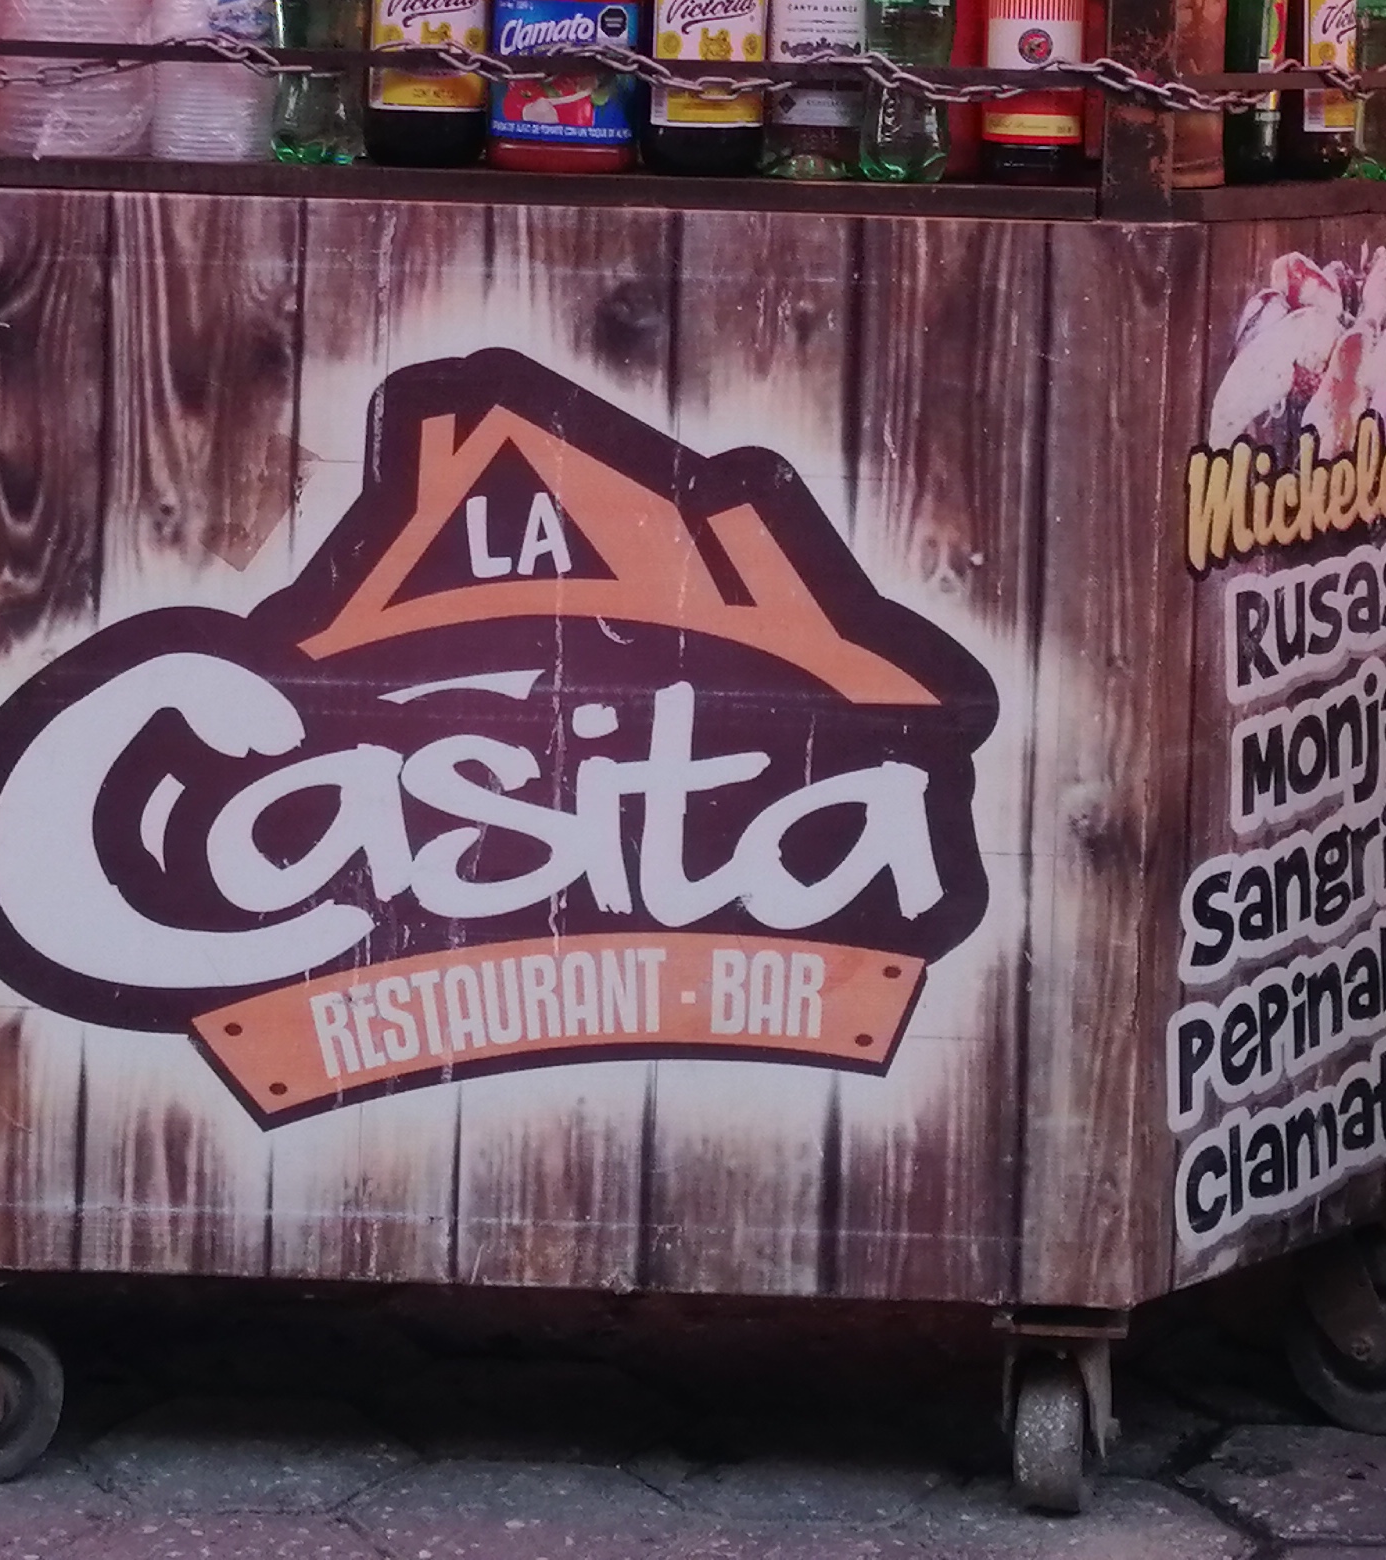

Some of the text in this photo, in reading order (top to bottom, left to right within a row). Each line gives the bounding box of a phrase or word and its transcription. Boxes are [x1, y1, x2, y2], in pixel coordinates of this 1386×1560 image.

[500, 13, 595, 56] Clamato
[465, 491, 572, 578] LA
[312, 946, 825, 1079] RESTAURANT BAR
